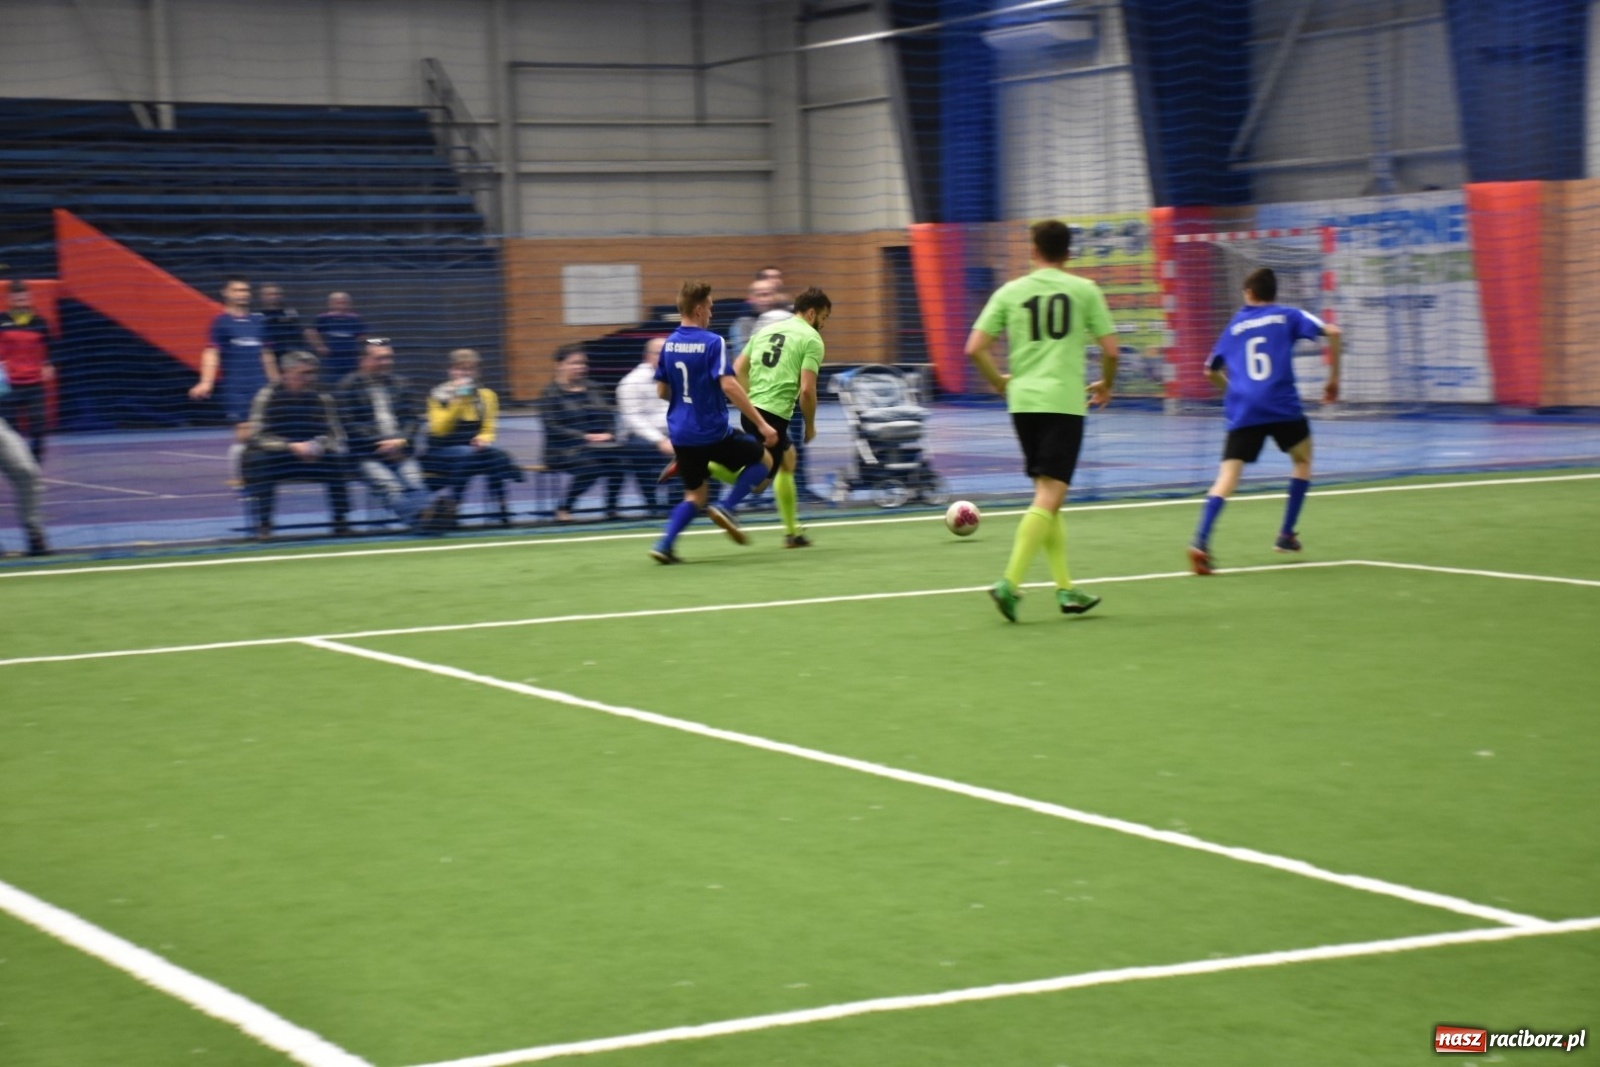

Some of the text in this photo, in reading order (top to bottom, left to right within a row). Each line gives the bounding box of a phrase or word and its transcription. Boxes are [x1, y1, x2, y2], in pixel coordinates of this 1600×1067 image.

[1022, 293, 1071, 341] 10
[761, 333, 786, 369] 3
[1245, 336, 1272, 381] 6
